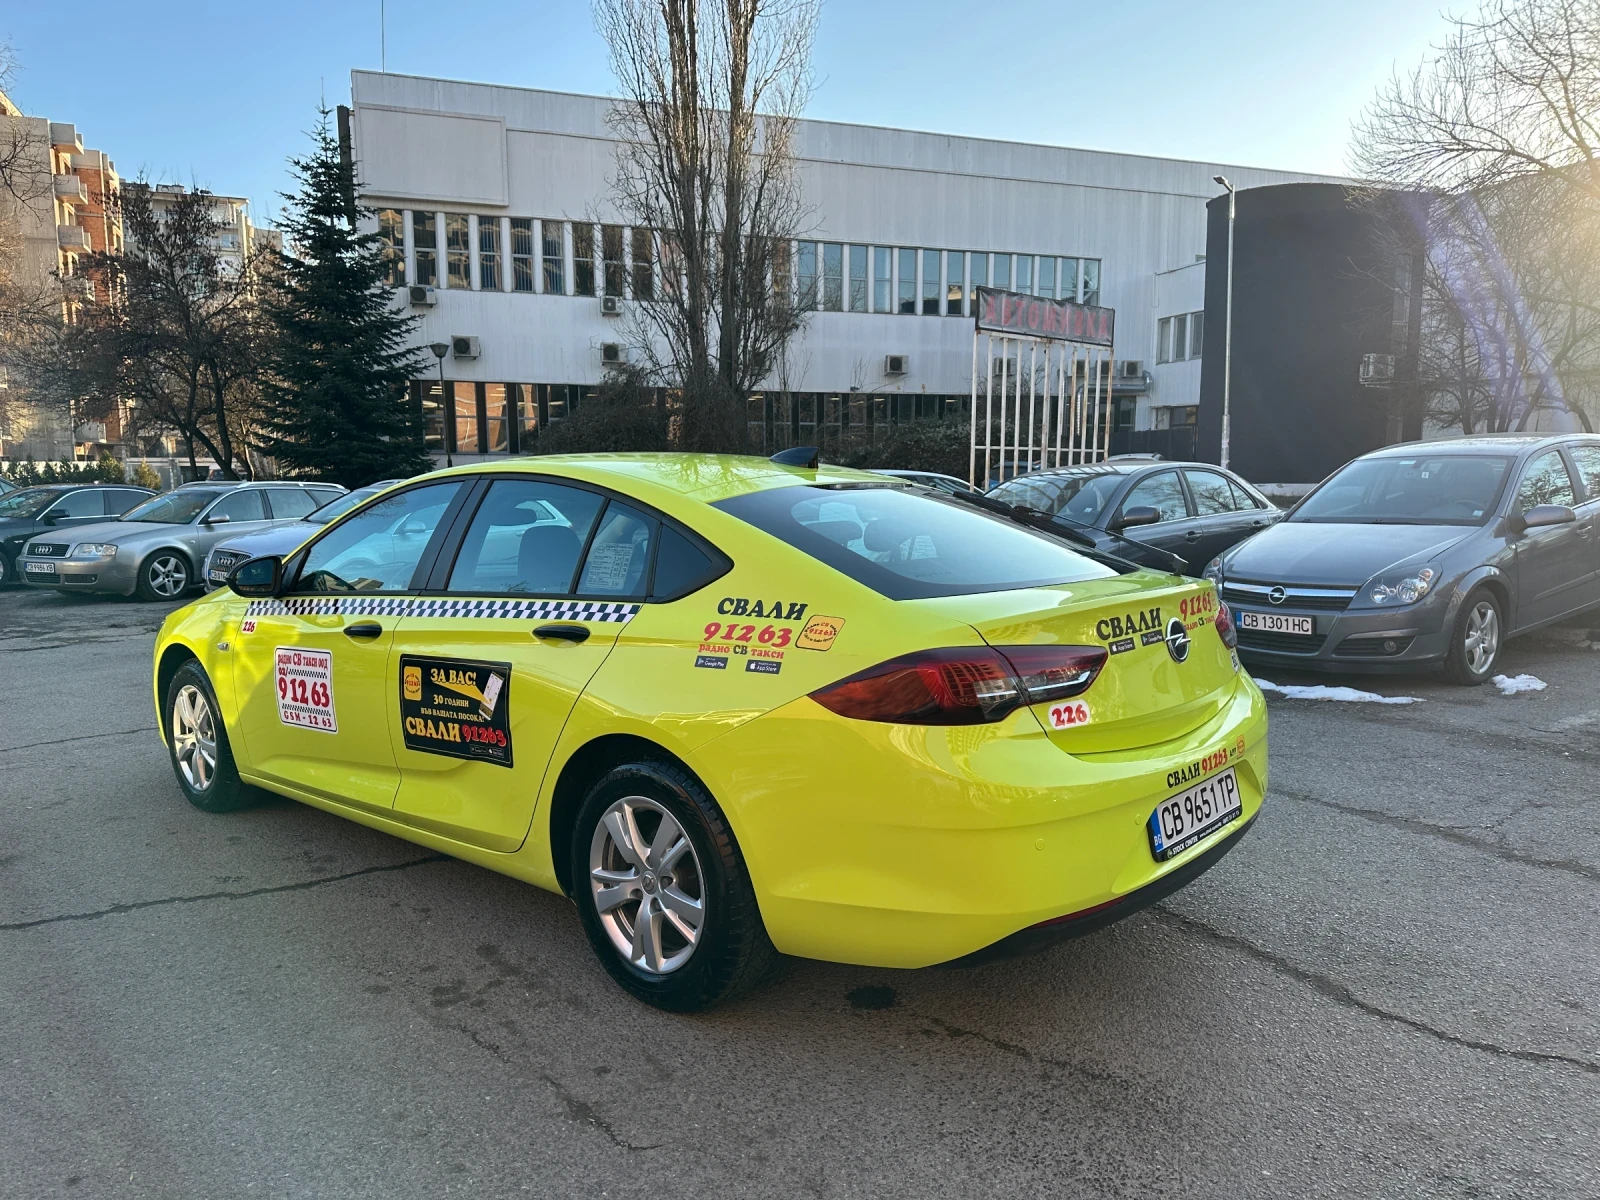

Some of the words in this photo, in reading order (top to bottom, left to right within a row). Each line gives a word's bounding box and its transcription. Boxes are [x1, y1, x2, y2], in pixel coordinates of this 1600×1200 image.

[985, 296, 1108, 338] АВТОМИВКА
[717, 597, 808, 620] СВАЛИ
[243, 621, 256, 632] 226
[1096, 607, 1162, 640] СВАЛИ
[1262, 616, 1290, 630] 1301
[698, 644, 730, 653] радио
[733, 644, 748, 655] СВ
[430, 668, 446, 683] ЗА
[449, 669, 477, 686] ВАС!
[433, 694, 444, 705] 30
[444, 698, 469, 707] ГОДИНИ
[284, 710, 301, 721] GSM
[433, 709, 457, 719] ВАШАТА
[1052, 704, 1087, 727] 226
[406, 716, 461, 742] СВАЛИ
[462, 724, 507, 747] 91263
[1166, 762, 1200, 788] СВАЛИ
[1202, 748, 1228, 776] 91263
[1184, 783, 1218, 828] 9651
[1154, 834, 1162, 846] BG
